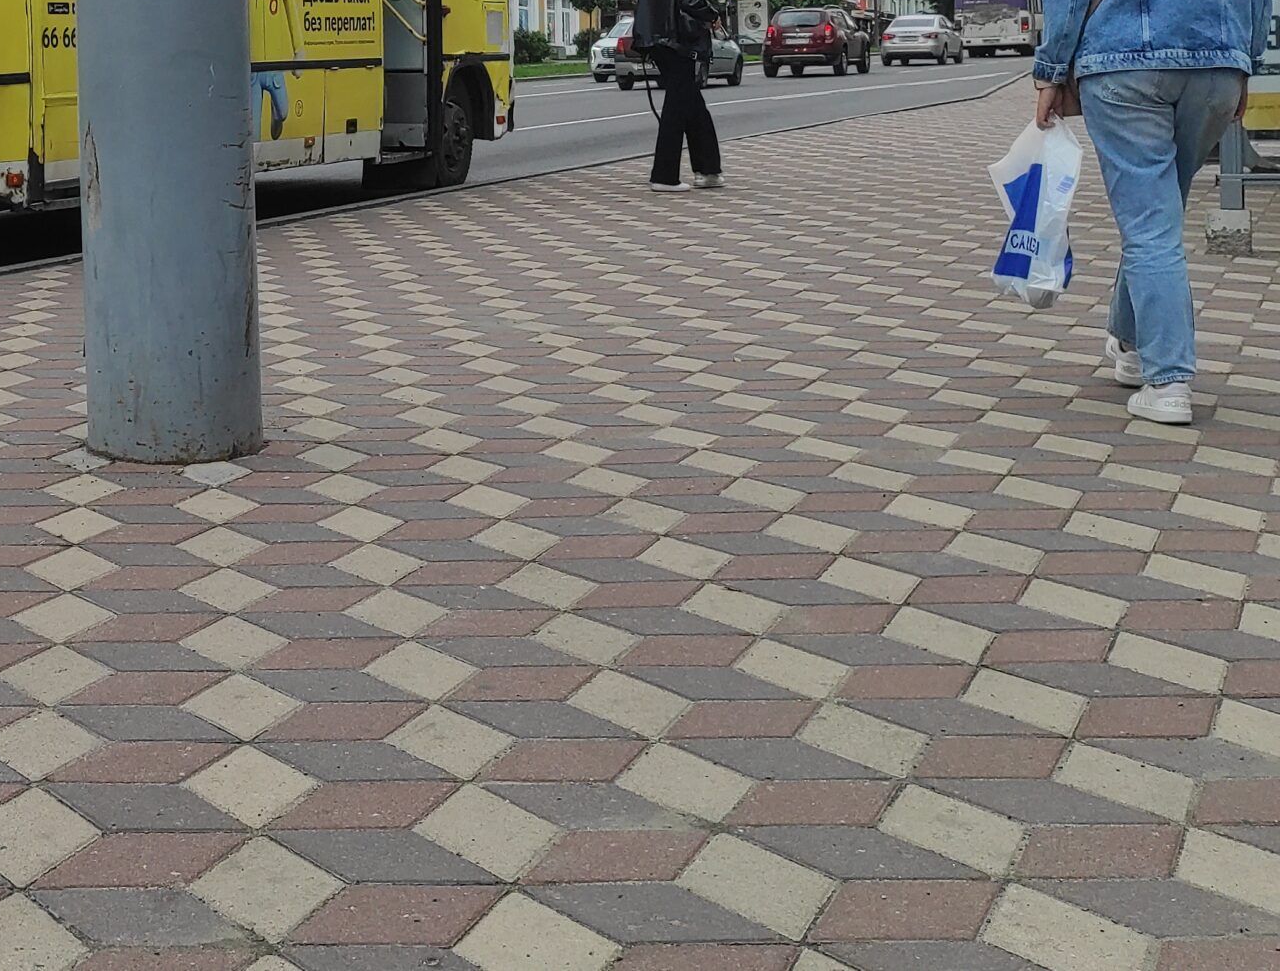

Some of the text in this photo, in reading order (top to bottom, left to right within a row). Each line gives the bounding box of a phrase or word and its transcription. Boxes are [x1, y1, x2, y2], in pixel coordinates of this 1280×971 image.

[304, 11, 375, 35] без переплат!
[42, 27, 59, 48] 66
